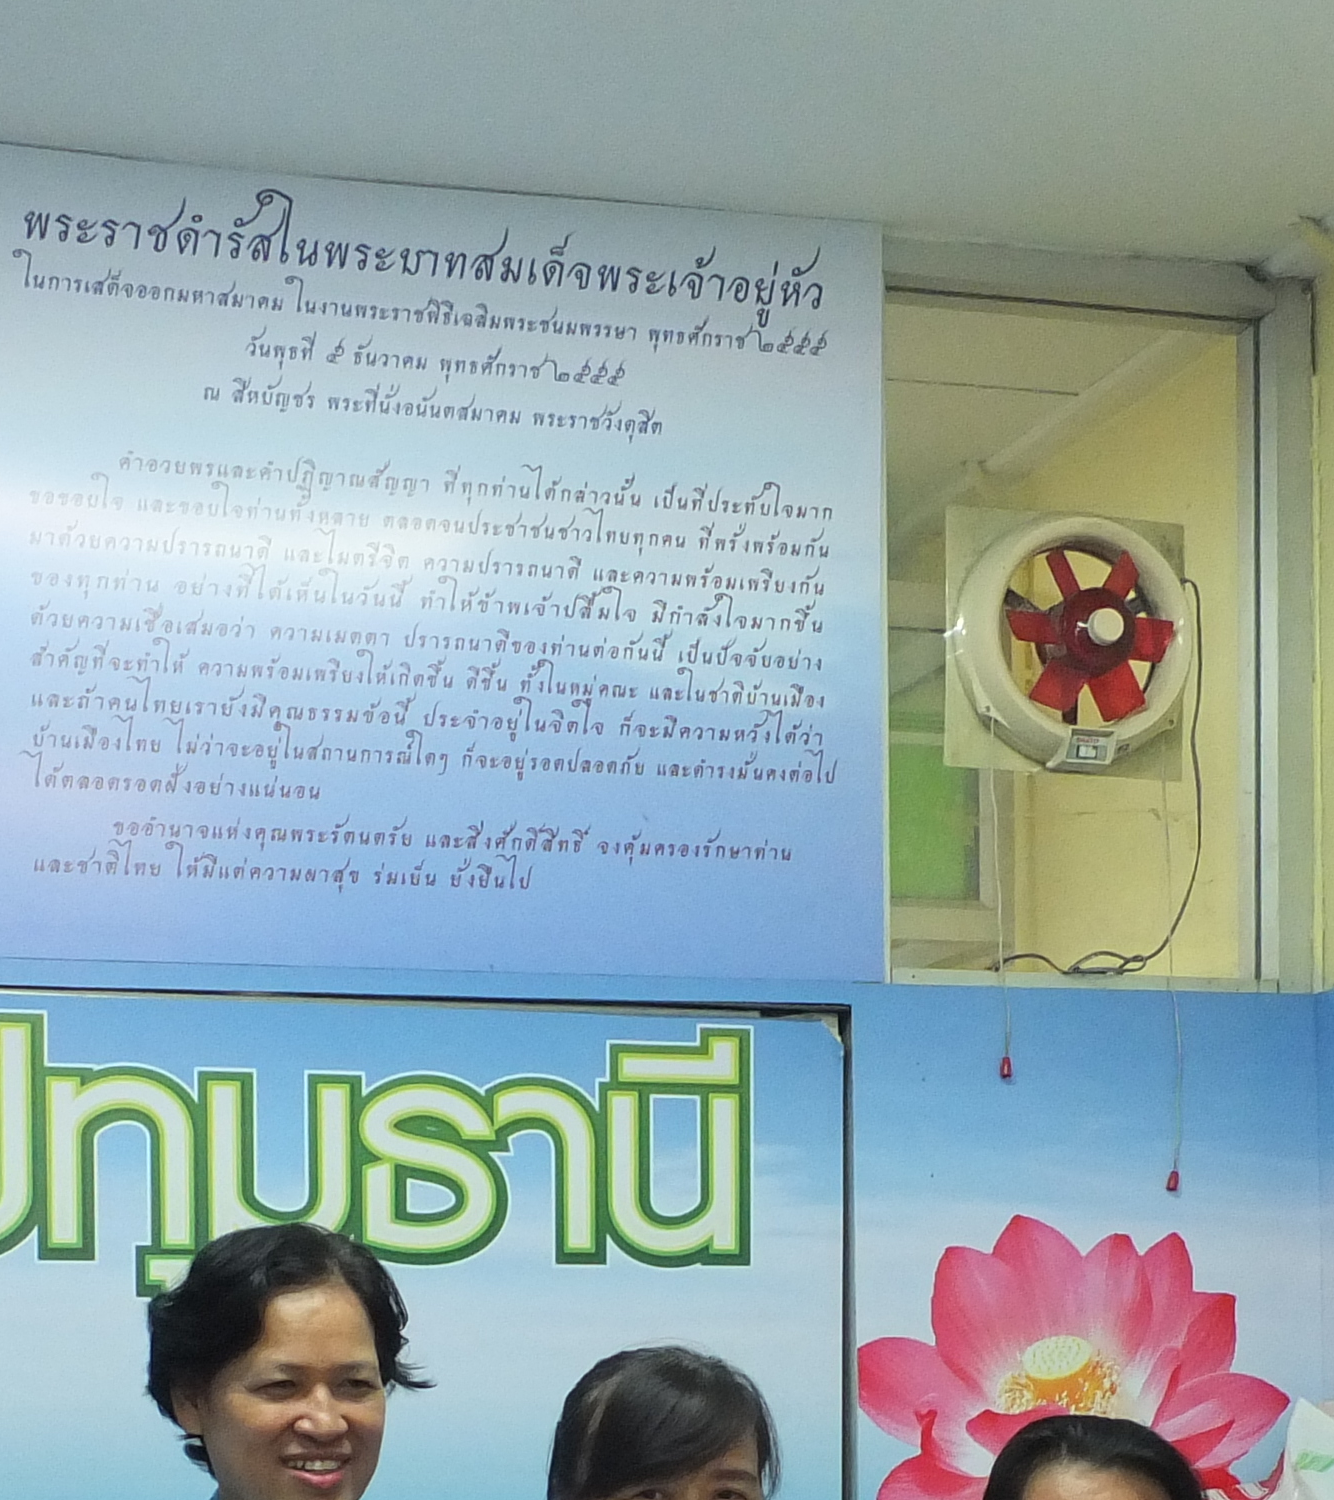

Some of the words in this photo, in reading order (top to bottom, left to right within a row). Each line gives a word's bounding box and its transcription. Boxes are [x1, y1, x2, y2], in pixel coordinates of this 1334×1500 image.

[12, 248, 285, 313] ในการเสด็จออกมหาสมาคม
[284, 275, 637, 341] ในงานพระราชพิธีเฉลิมพระชนมพรรษา
[245, 325, 316, 371] วันพุธที่
[325, 337, 346, 364] ๕
[353, 340, 427, 373] ธันวาคม
[203, 385, 220, 402] ณ
[231, 375, 316, 413] สีหบัญชร
[327, 382, 521, 425] พระที่นั่งอนันตสมาคม
[532, 399, 664, 444] พระราชวังดุสิต
[443, 464, 642, 508] ที่ทุกท่านได้กล่าวนั้น
[29, 471, 124, 511] ขอขอบใจ
[382, 507, 687, 556] ตลอดจนประชาชนชาวไทยทุกคน
[29, 520, 273, 562] มาด้วยความปรารถนาดี
[283, 527, 410, 568] และไมตรีจิต
[424, 548, 583, 582] ความปรารถนาดี
[30, 569, 160, 601] ของทุกท่าน
[651, 593, 824, 635] มีกำลังใจมากขึ้น
[29, 600, 255, 640] ด้วยความเชื่อเสมอว่า
[269, 624, 391, 647] ความเมตตา
[677, 637, 824, 674] เป็นปัจจัยอย่าง
[649, 667, 827, 710] และในชาติบ้านเมือง
[32, 714, 161, 754] บ้านเมืองไทย
[619, 709, 825, 747] ก็จะมีความหวังได้ว่า
[33, 839, 161, 878] และชาติไทย
[373, 858, 438, 888] ร่มเย็น
[450, 854, 535, 890] ยั่งยืนไป
[113, 814, 413, 852] ขออำนาจแห่งคุณพระรัตนตรัย
[597, 827, 793, 866] จงคุ้มครองรักษาท่าน
